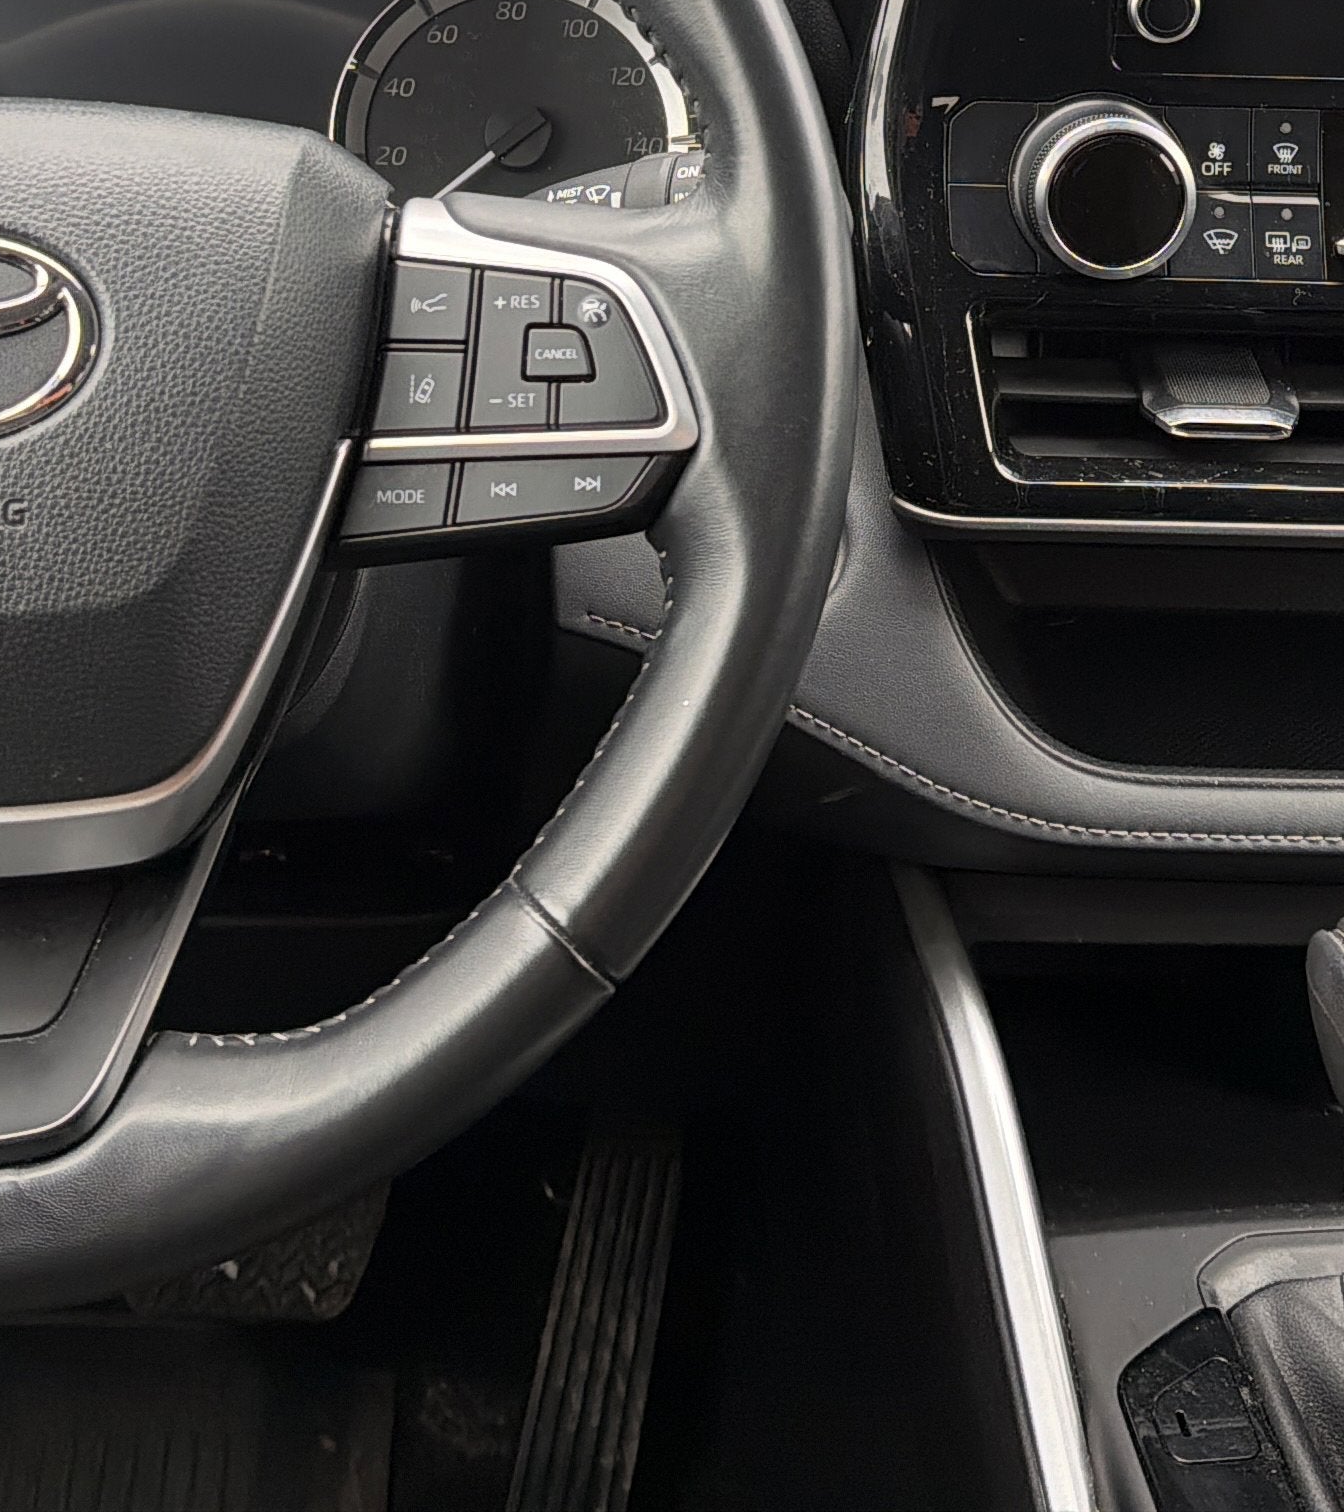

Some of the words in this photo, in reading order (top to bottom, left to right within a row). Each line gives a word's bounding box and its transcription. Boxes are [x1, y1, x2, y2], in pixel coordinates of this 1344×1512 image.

[495, 1, 527, 21] 80
[427, 24, 458, 45] 60
[562, 19, 599, 39] 100
[609, 67, 646, 86] 120
[384, 78, 416, 98] 40
[624, 137, 662, 155] 140
[375, 146, 407, 166] 20
[676, 165, 701, 179] ON
[1201, 161, 1233, 176] OFF
[1267, 163, 1303, 175] FRONT
[1273, 253, 1304, 266] REAR
[534, 348, 579, 361] CANCEL
[376, 489, 426, 504] MODE
